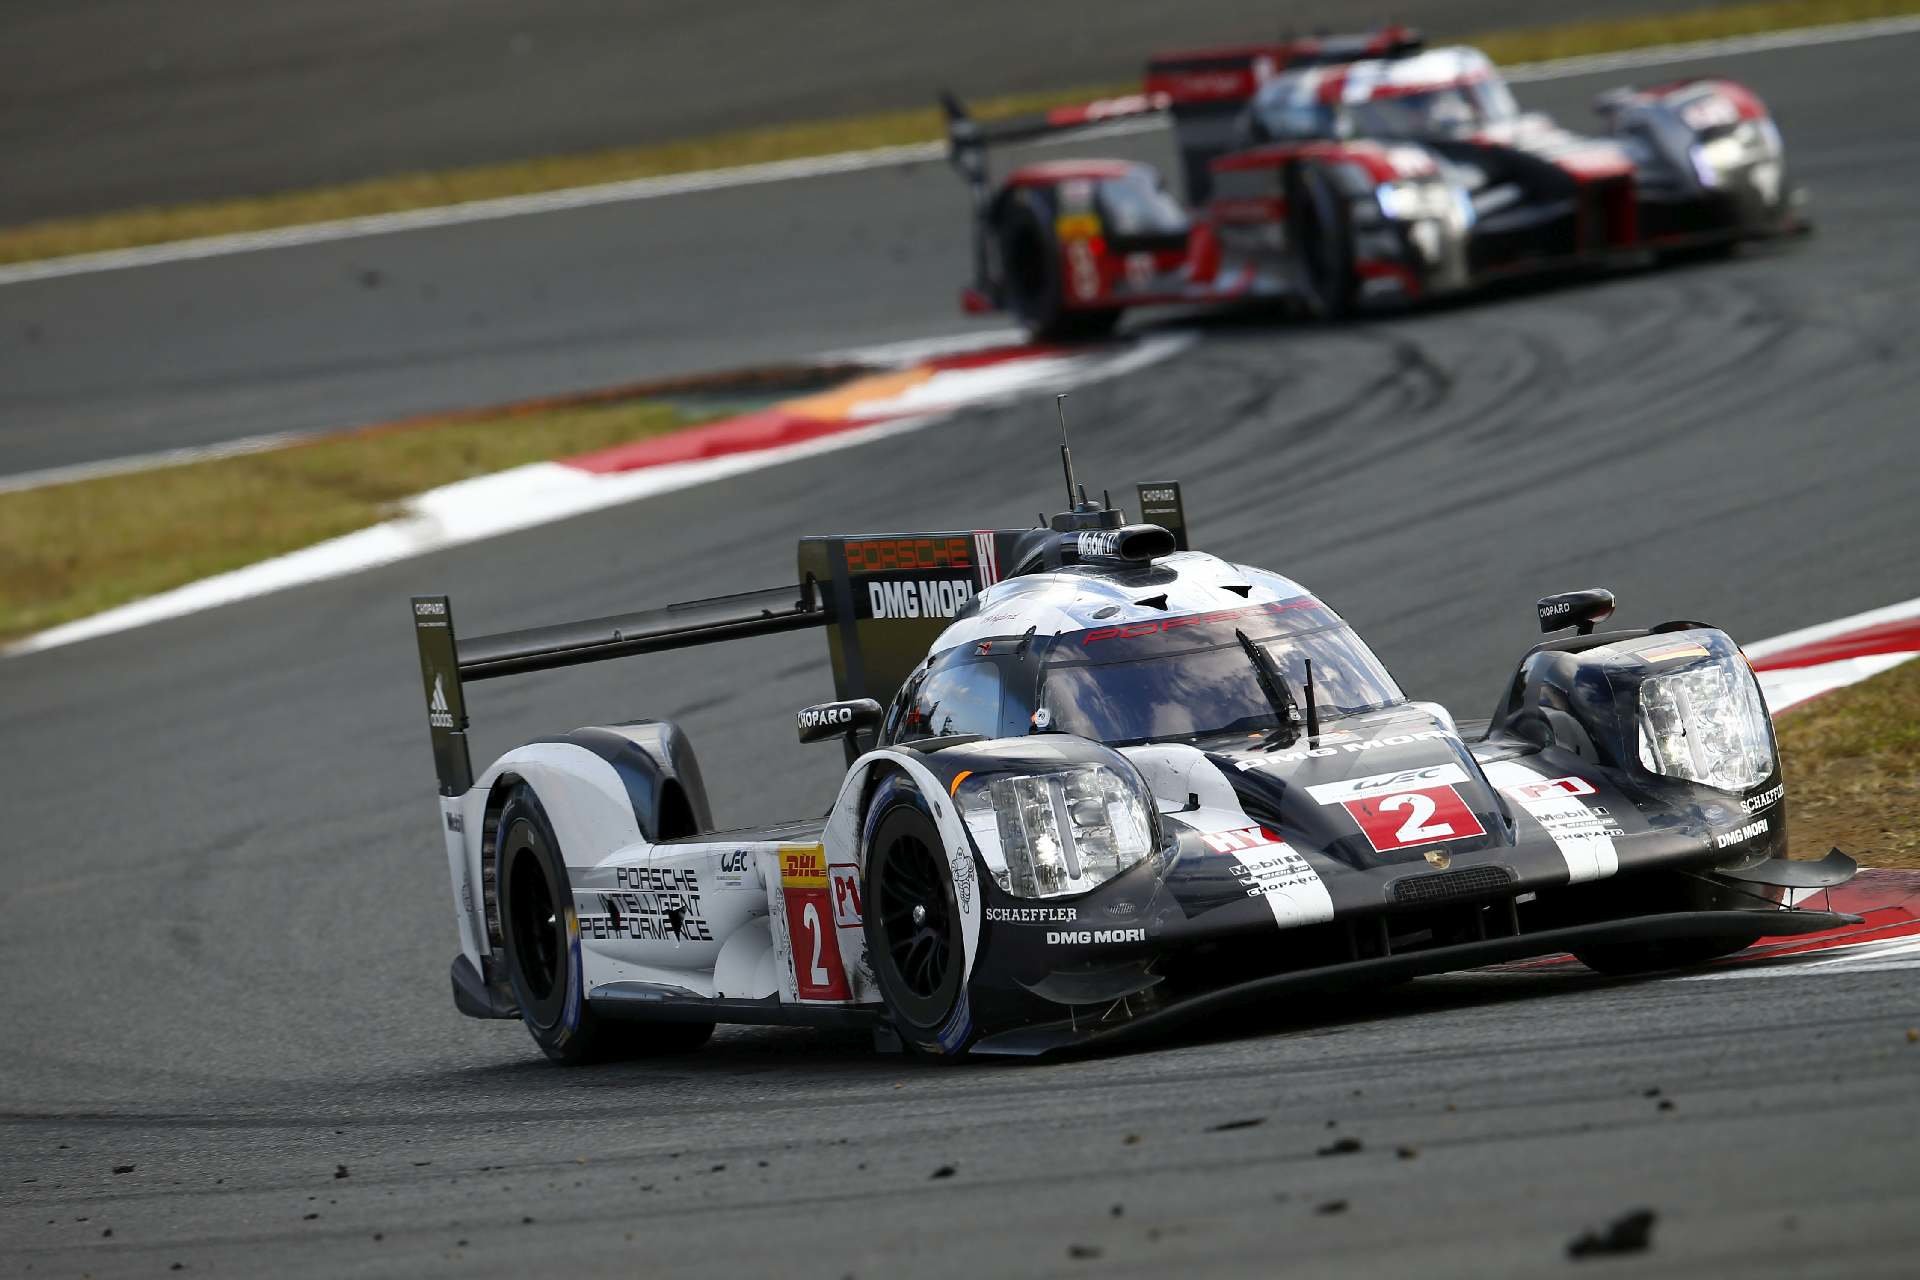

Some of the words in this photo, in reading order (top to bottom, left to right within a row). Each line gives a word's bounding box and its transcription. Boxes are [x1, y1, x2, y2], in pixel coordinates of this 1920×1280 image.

[844, 537, 969, 572] PORSCHE
[1078, 531, 1105, 555] Mobil
[974, 533, 998, 589] HY
[415, 603, 445, 615] CHOPARD
[868, 581, 919, 619] DMG
[919, 579, 976, 618] MORI
[1539, 602, 1570, 618] CHOPARD
[430, 710, 454, 727] adidas
[797, 708, 852, 729] CHOPARD
[1234, 748, 1338, 772] DMG
[1353, 768, 1441, 791] WEC
[1519, 780, 1581, 798] P1
[1378, 793, 1455, 843] 2
[1536, 810, 1589, 822] Mobil
[1200, 827, 1271, 853] HY
[1554, 829, 1623, 841] CHOPARD
[1717, 830, 1744, 849] DMG
[1743, 819, 1769, 840] MORI
[721, 850, 748, 872] WEC
[786, 854, 821, 877] DHL
[1230, 858, 1284, 875] Mobil
[617, 867, 699, 891] PORSCHE
[1248, 876, 1319, 896] CHOPARD
[597, 893, 701, 917] INTELLIGENT
[834, 876, 863, 917] P1
[986, 907, 1077, 922] SCHAEFFLER
[578, 917, 713, 941] PERFORMANCE
[1047, 931, 1091, 944] DMG
[1094, 929, 1145, 944] MORI
[803, 902, 830, 986] 2
